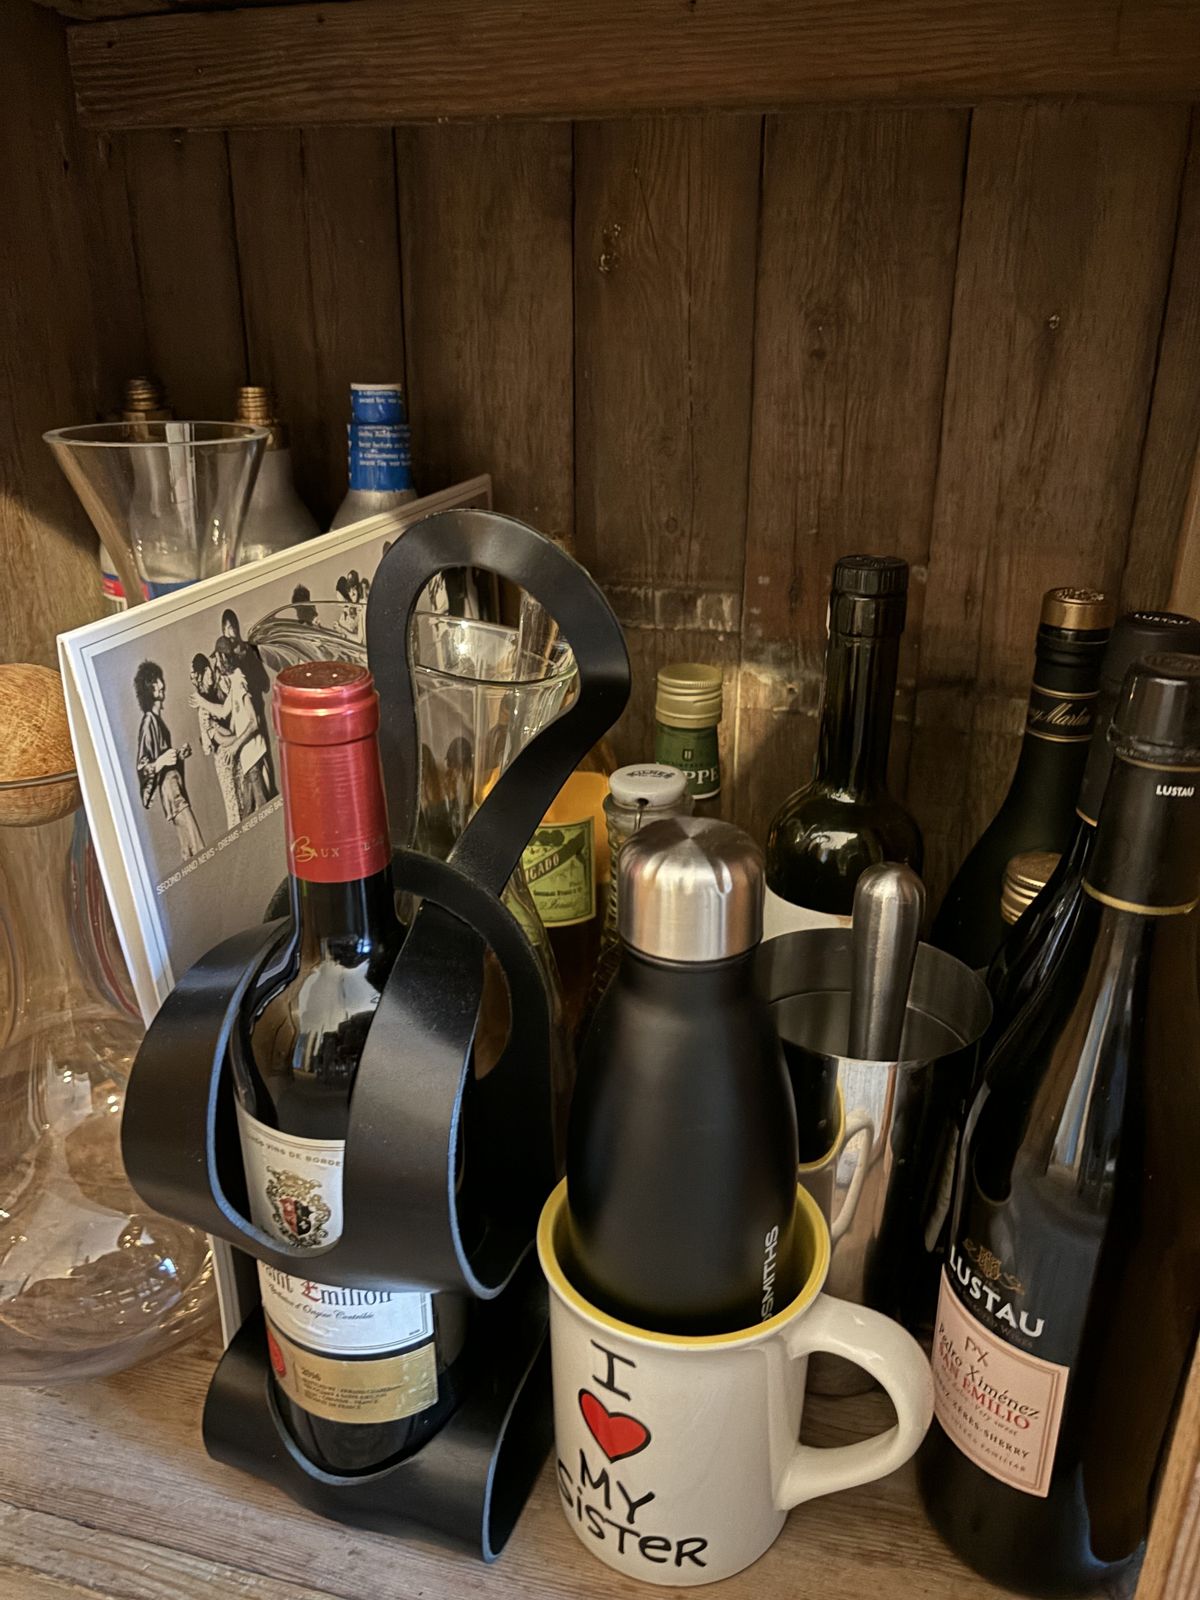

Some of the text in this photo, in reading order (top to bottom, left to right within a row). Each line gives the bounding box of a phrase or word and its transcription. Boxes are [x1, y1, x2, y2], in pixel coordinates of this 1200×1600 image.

[1133, 613, 1191, 625] LUSTAU
[1155, 784, 1195, 797] LUSTAU
[156, 872, 181, 895] SECOND
[181, 860, 198, 877] HAND
[198, 847, 216, 865] NEWS
[217, 830, 240, 851] DREAMS
[241, 816, 259, 832] NEVER
[258, 804, 274, 821] GOING
[264, 1265, 294, 1294] aint
[760, 1225, 779, 1320] SMITHS
[949, 1244, 1046, 1338] LUSTAU
[590, 1338, 638, 1402] I
[938, 1322, 963, 1368] Pedro
[966, 1364, 1042, 1421] Ximénez
[939, 1342, 961, 1380] SAN
[962, 1377, 1031, 1430] EMILIO
[579, 1447, 656, 1525] MY
